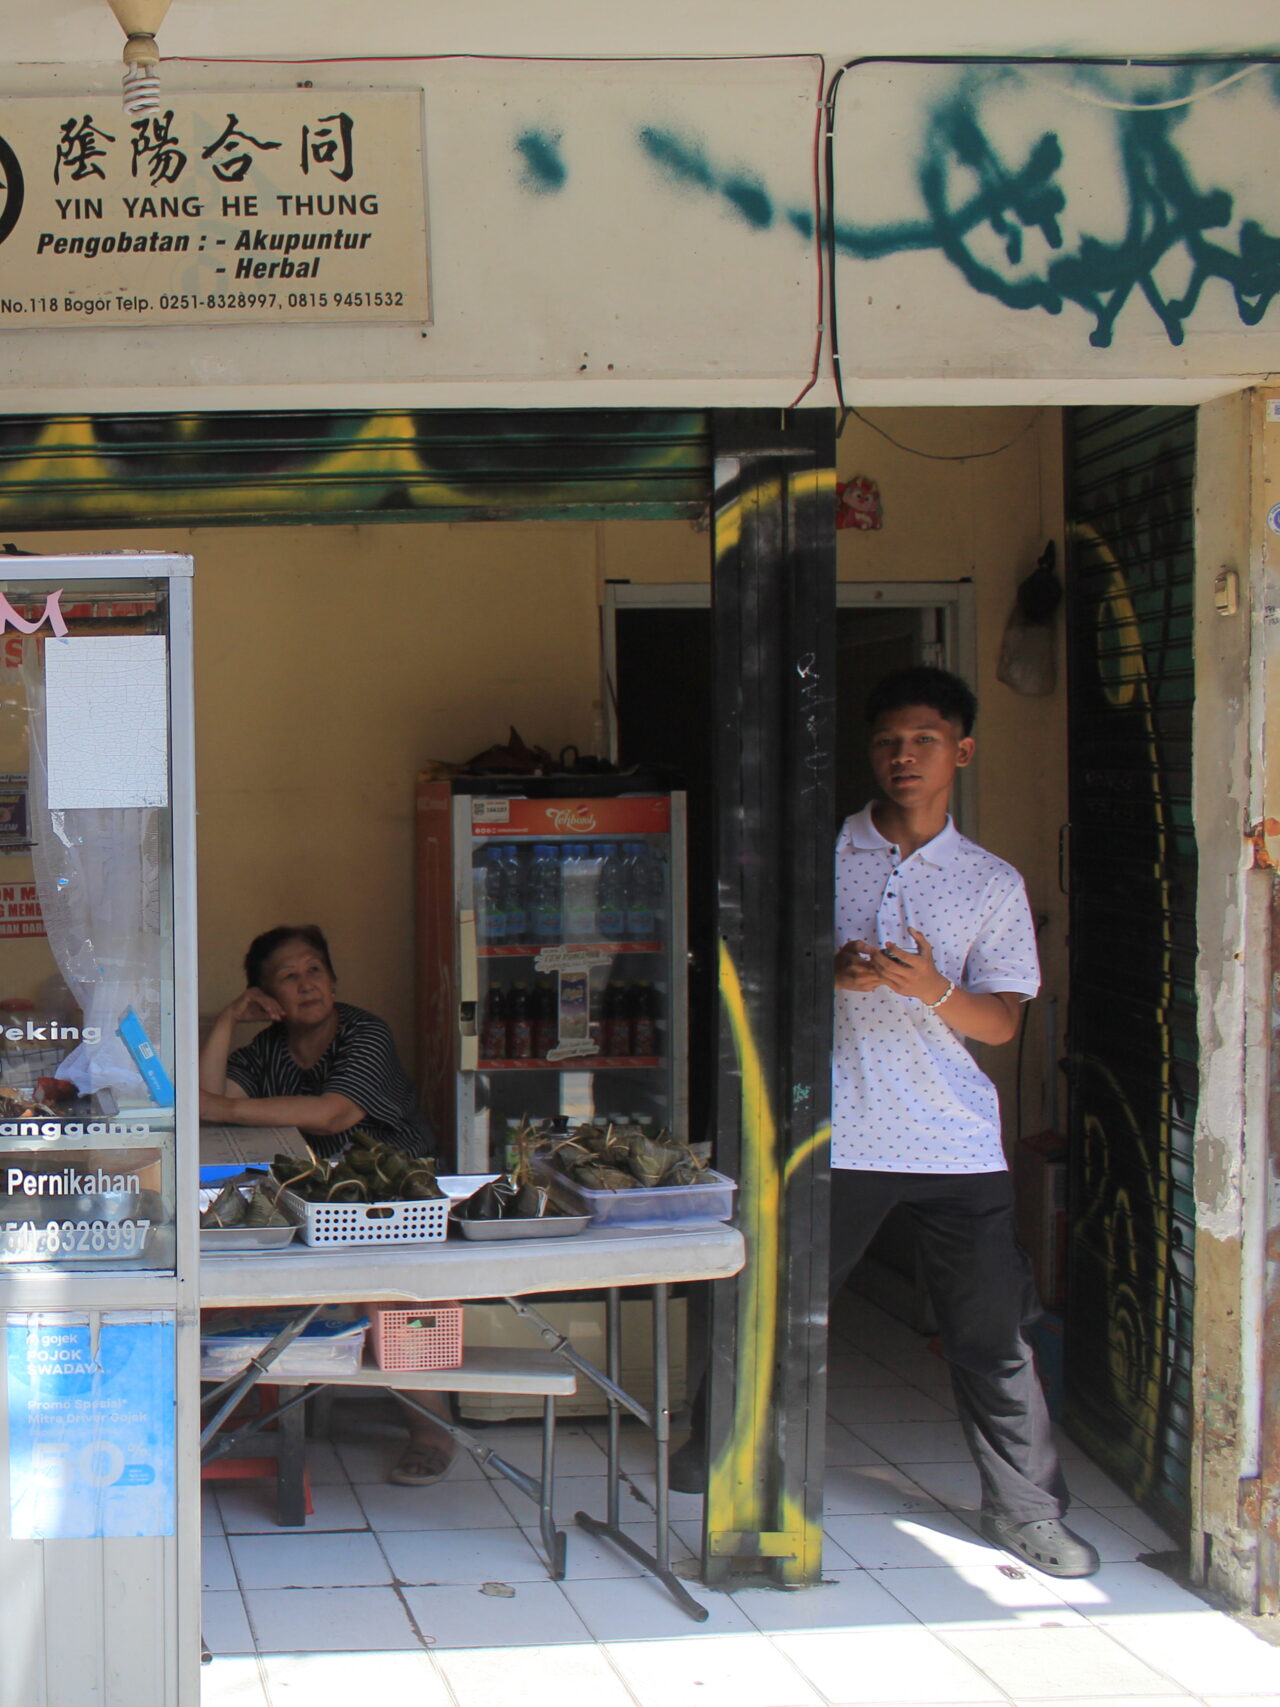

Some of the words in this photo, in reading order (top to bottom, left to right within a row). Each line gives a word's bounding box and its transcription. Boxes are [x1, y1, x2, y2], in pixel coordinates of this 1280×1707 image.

[55, 198, 103, 220] YIN
[122, 197, 203, 219] YANG
[222, 196, 259, 217] HE
[277, 194, 380, 216] THUNG
[36, 231, 190, 259] Pengobatan
[235, 229, 373, 255] Akupuntur
[235, 257, 320, 279] Herbal
[64, 296, 113, 315] Bogor
[115, 296, 155, 314] Telp.
[288, 292, 329, 308] 0815
[333, 291, 404, 308] 9451532
[7, 1168, 141, 1197] Pernikahan
[46, 1219, 152, 1252] 8328997
[41, 1334, 79, 1347] gojek
[26, 1350, 82, 1362] POJOK
[26, 1362, 105, 1376] SWADAYA
